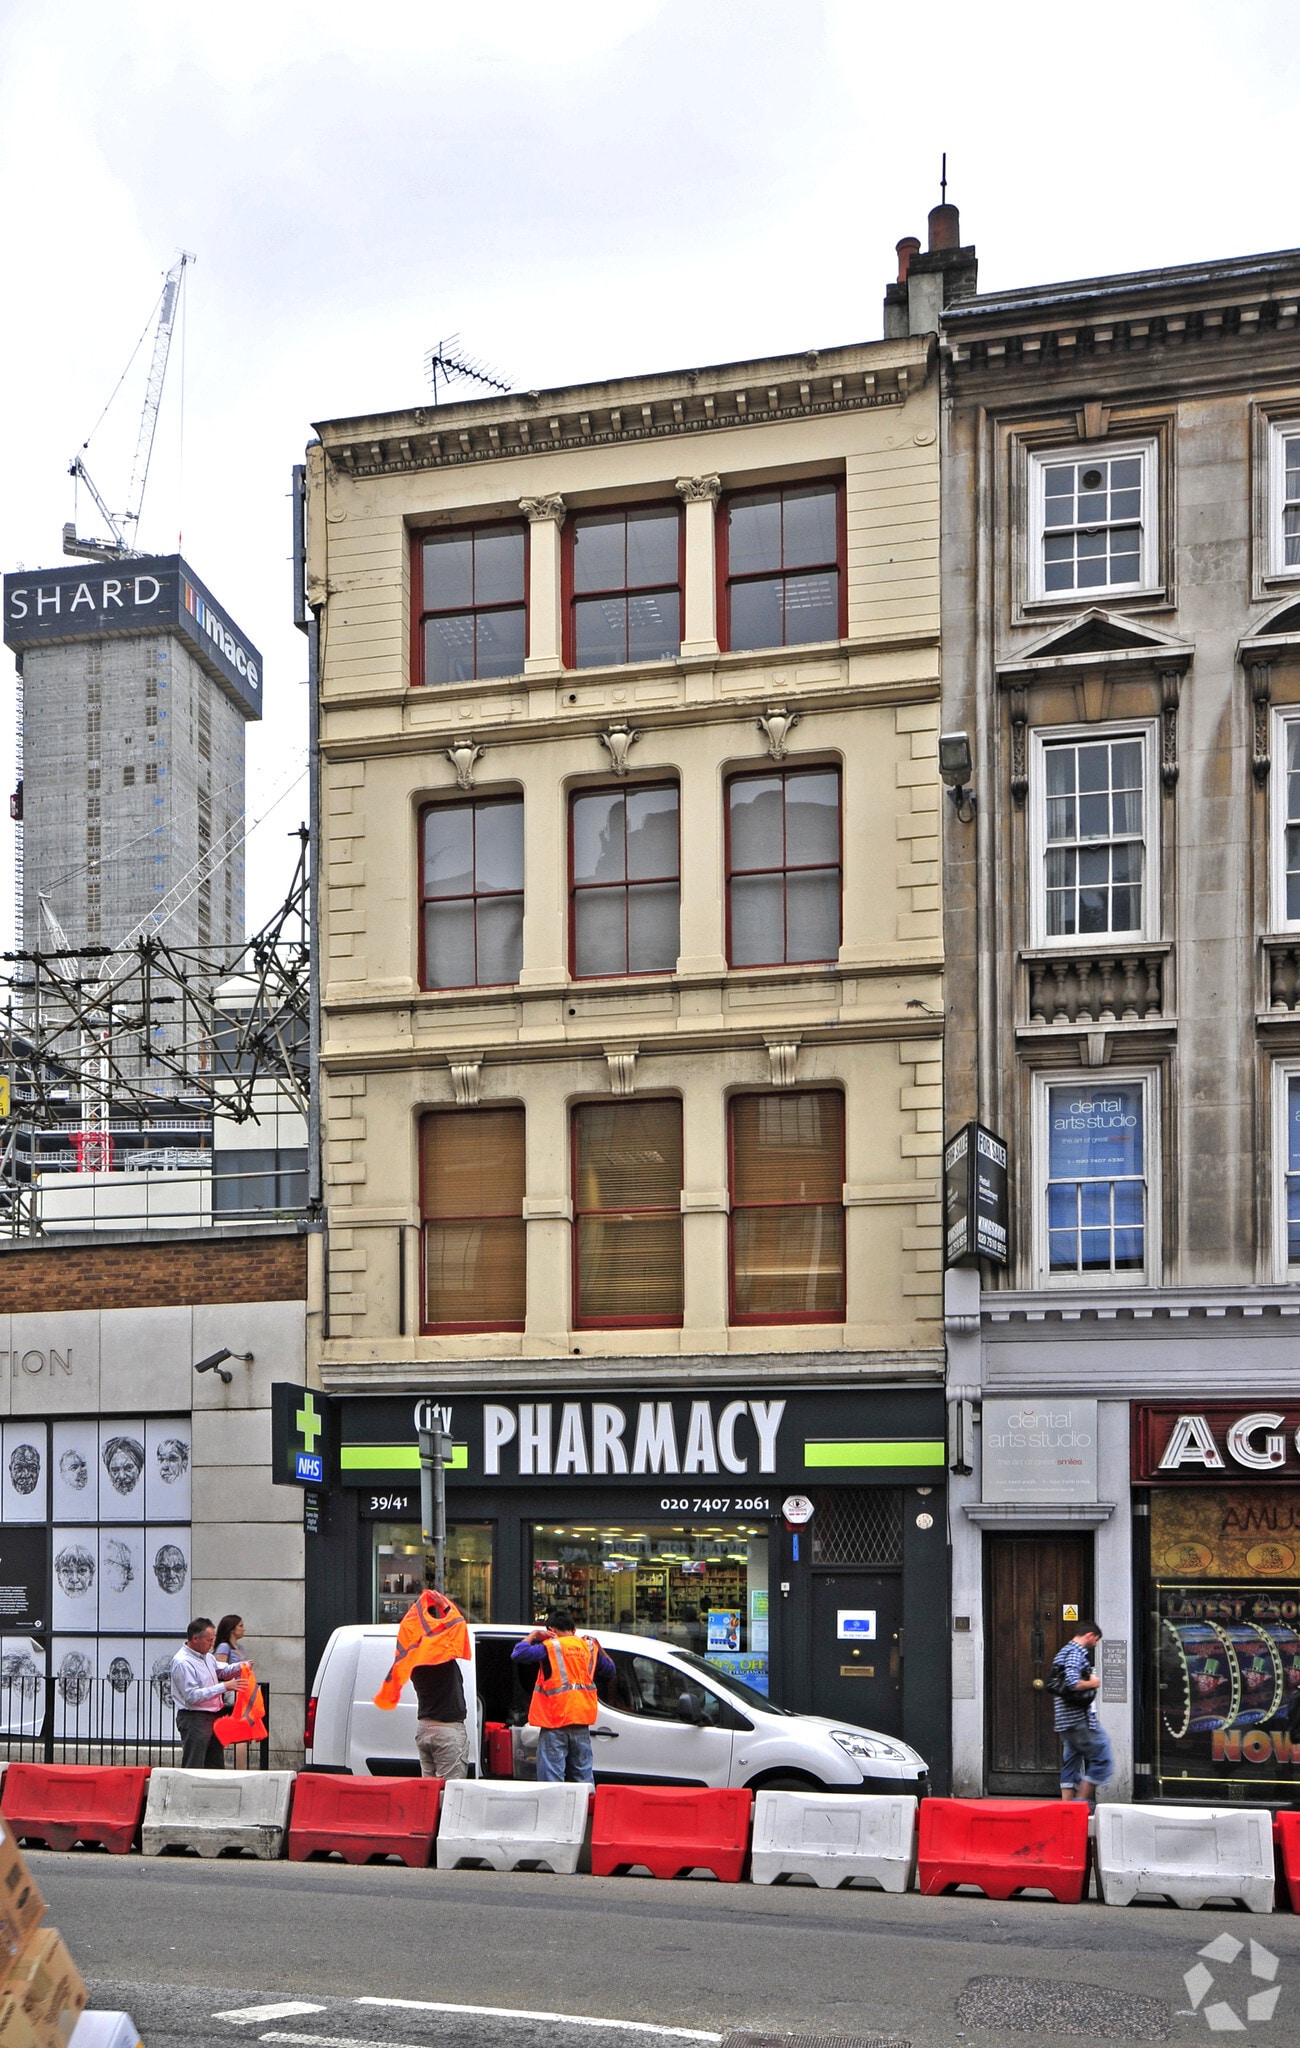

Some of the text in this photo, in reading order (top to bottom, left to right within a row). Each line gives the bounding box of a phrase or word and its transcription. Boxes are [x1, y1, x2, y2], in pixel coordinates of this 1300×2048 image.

[10, 575, 161, 620] SHARD
[205, 606, 260, 691] mace
[1069, 1097, 1122, 1114] dental
[1054, 1113, 1137, 1131] arts studio
[979, 1133, 1006, 1166] FOR SALE
[1007, 1410, 1072, 1429] dental
[483, 1400, 787, 1475] PHARMACY
[988, 1430, 1092, 1448] arts studio
[1158, 1413, 1300, 1470] AG
[298, 1457, 320, 1477] NHS
[1056, 1458, 1083, 1466] smiles
[370, 1494, 408, 1510] 39/41
[660, 1496, 770, 1512] 020 7407 2061
[1167, 1600, 1300, 1618] LATEST £50
[740, 1660, 766, 1670] OFF
